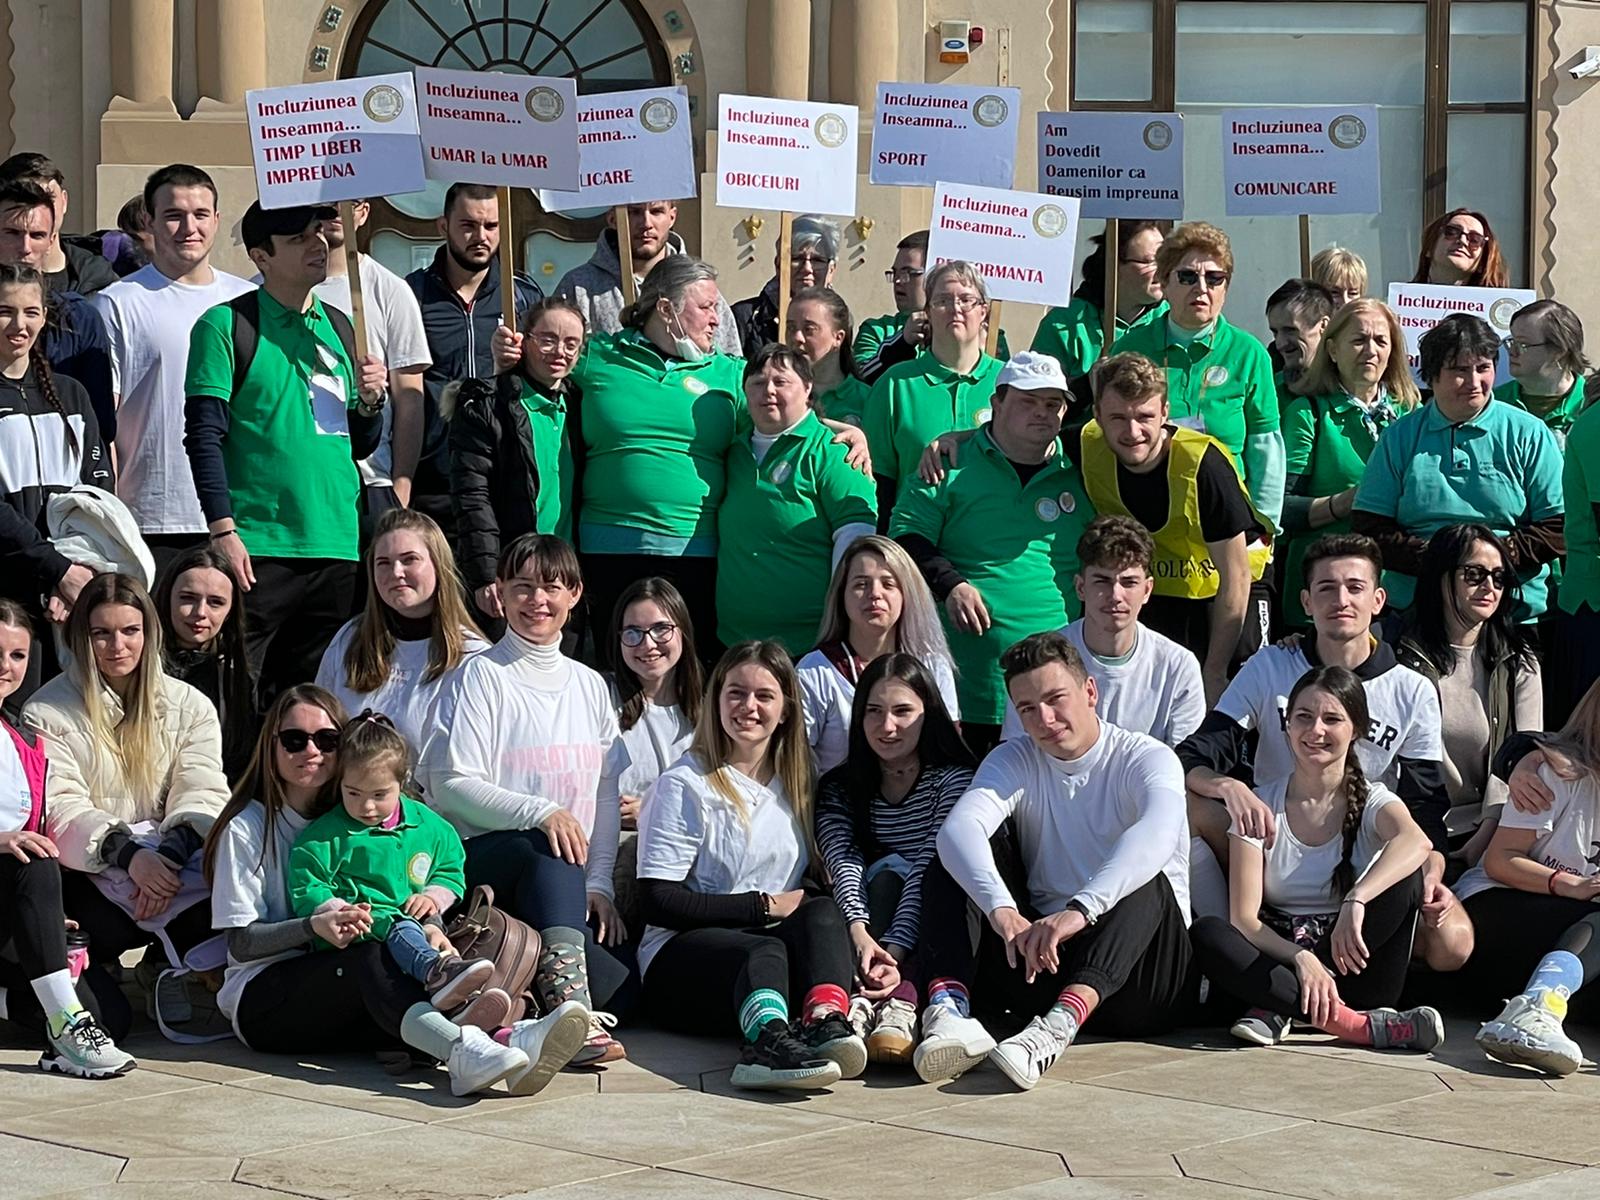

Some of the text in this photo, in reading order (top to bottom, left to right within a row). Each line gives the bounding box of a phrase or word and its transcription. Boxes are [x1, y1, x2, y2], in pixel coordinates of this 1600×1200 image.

[426, 82, 520, 103] Incluziunea
[884, 92, 968, 110] Incluziunea
[258, 96, 357, 117] Incluziunea
[427, 104, 522, 124] Inseamna...
[727, 108, 810, 128] Incluziunea
[882, 112, 967, 129] Inseamna...
[1231, 120, 1323, 134] Incluziunea
[261, 120, 361, 140] Inseamna...
[727, 129, 810, 149] Inseamna...
[1045, 123, 1068, 137] Am
[263, 138, 362, 162] TIMP LIBER
[431, 146, 548, 169] UMAR la UMAR
[1045, 144, 1101, 158] Dovedit
[1232, 142, 1324, 155] Inseamna...
[878, 151, 928, 167] SPORT
[266, 162, 356, 185] IMPREUNA
[725, 171, 800, 191] OBICEIURI
[1045, 164, 1146, 179] Oamenilor ca
[1046, 184, 1179, 201] Reusim impreuna
[1234, 181, 1338, 196] COMUNICARE
[943, 194, 1028, 218] Incluziunea
[940, 215, 1026, 239] Inseamna...
[1397, 294, 1485, 312] Incluziunea
